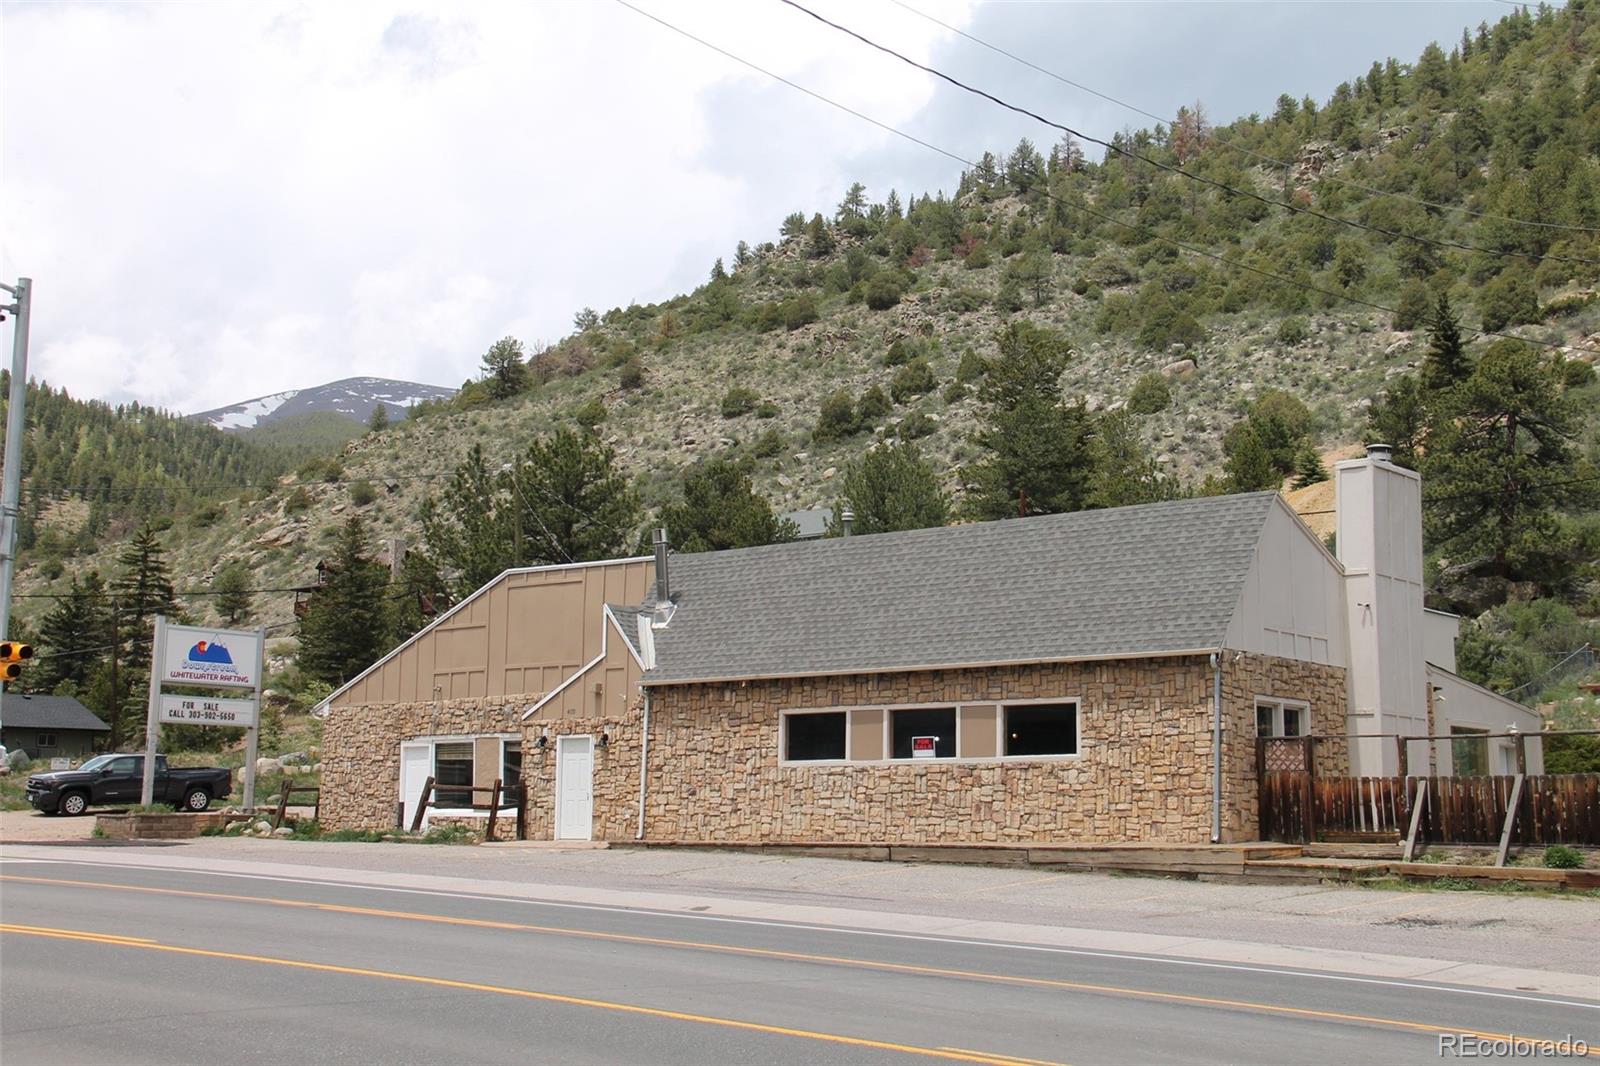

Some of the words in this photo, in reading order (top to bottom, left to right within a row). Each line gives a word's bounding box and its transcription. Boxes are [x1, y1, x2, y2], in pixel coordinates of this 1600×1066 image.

[170, 671, 219, 680] WHITEWATER
[219, 674, 249, 683] RAFTING
[182, 701, 194, 709] FOR
[203, 703, 219, 711] SALE
[169, 709, 185, 718] CALL
